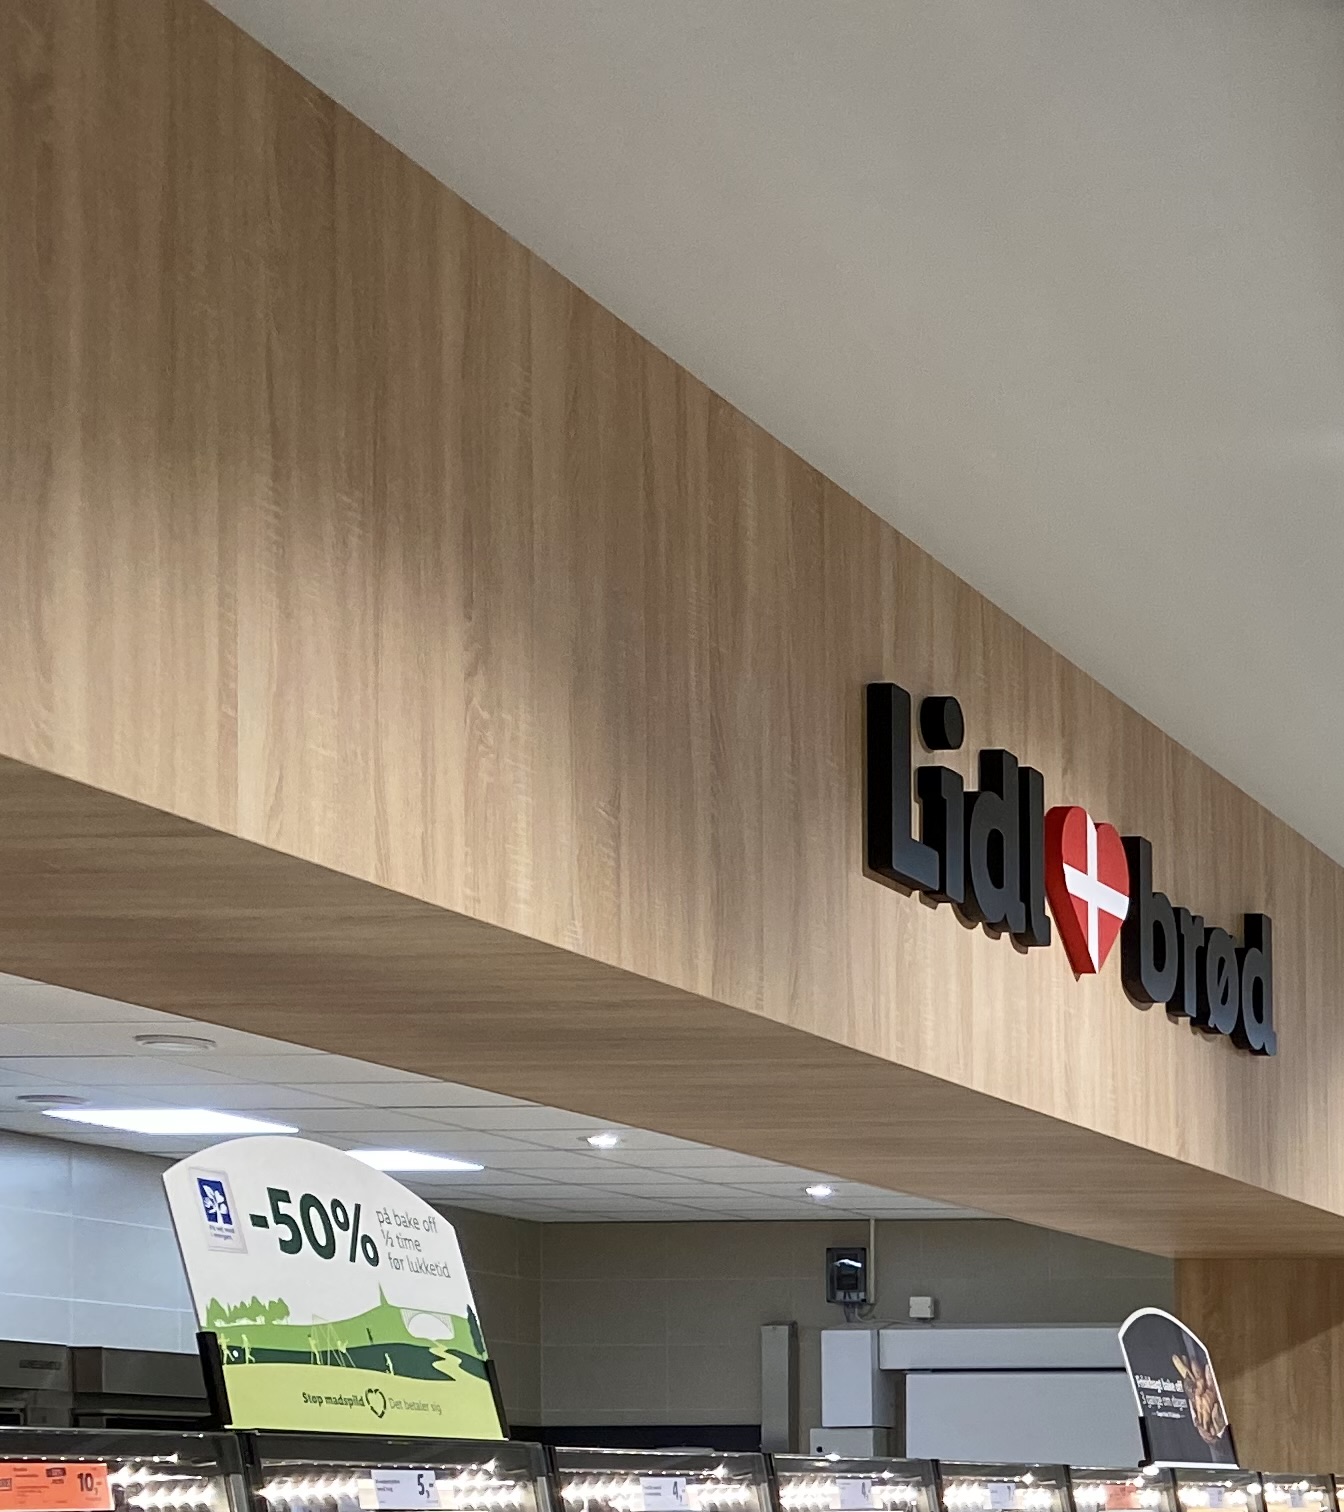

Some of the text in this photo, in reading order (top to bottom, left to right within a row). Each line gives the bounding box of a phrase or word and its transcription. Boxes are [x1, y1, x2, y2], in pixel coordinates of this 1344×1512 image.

[867, 682, 1276, 1056] Lidl brød
[249, 1187, 380, 1267] -50%
[376, 1208, 438, 1234] på bake off
[396, 1233, 422, 1252] time
[388, 1252, 451, 1278] før lukketid
[302, 1392, 365, 1409] Stop madspild
